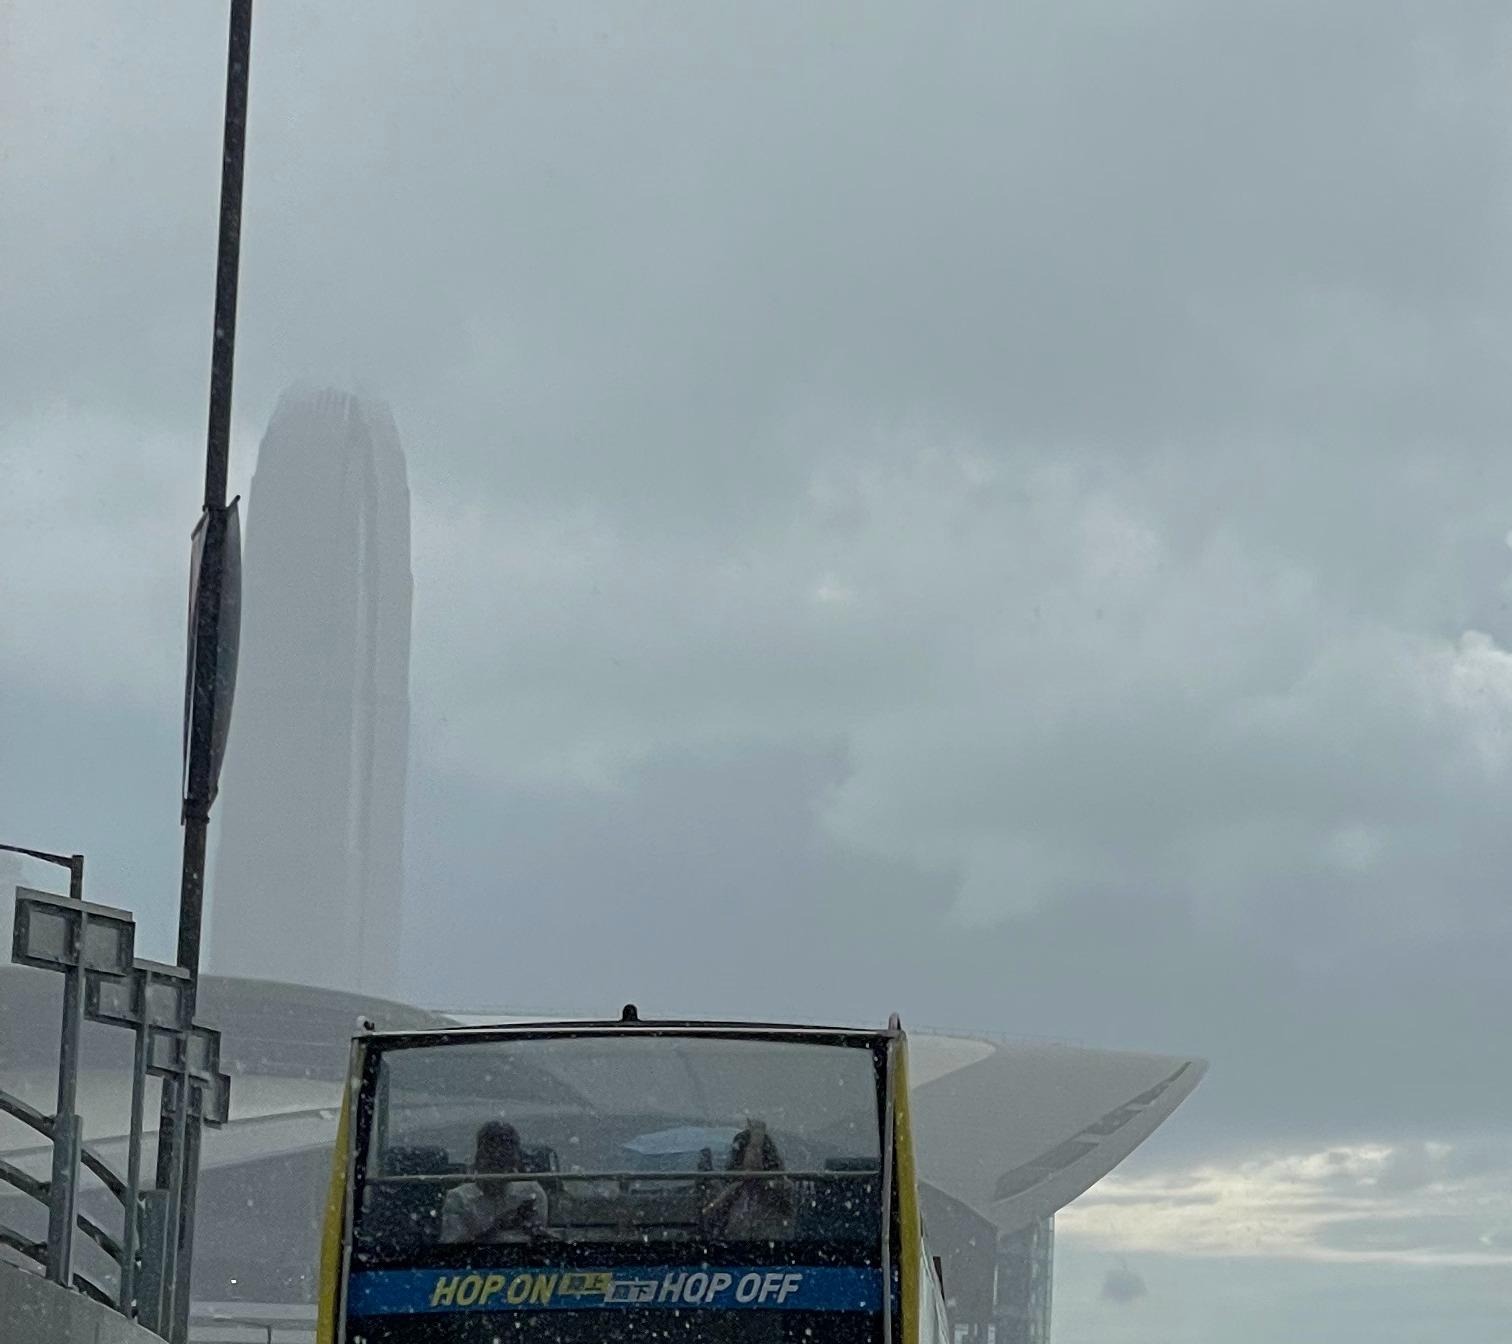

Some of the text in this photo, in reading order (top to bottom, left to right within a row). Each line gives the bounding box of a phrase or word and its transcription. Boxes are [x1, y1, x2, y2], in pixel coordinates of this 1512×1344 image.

[431, 1273, 559, 1307] HOP ON
[657, 1272, 803, 1305] HOP OFF
